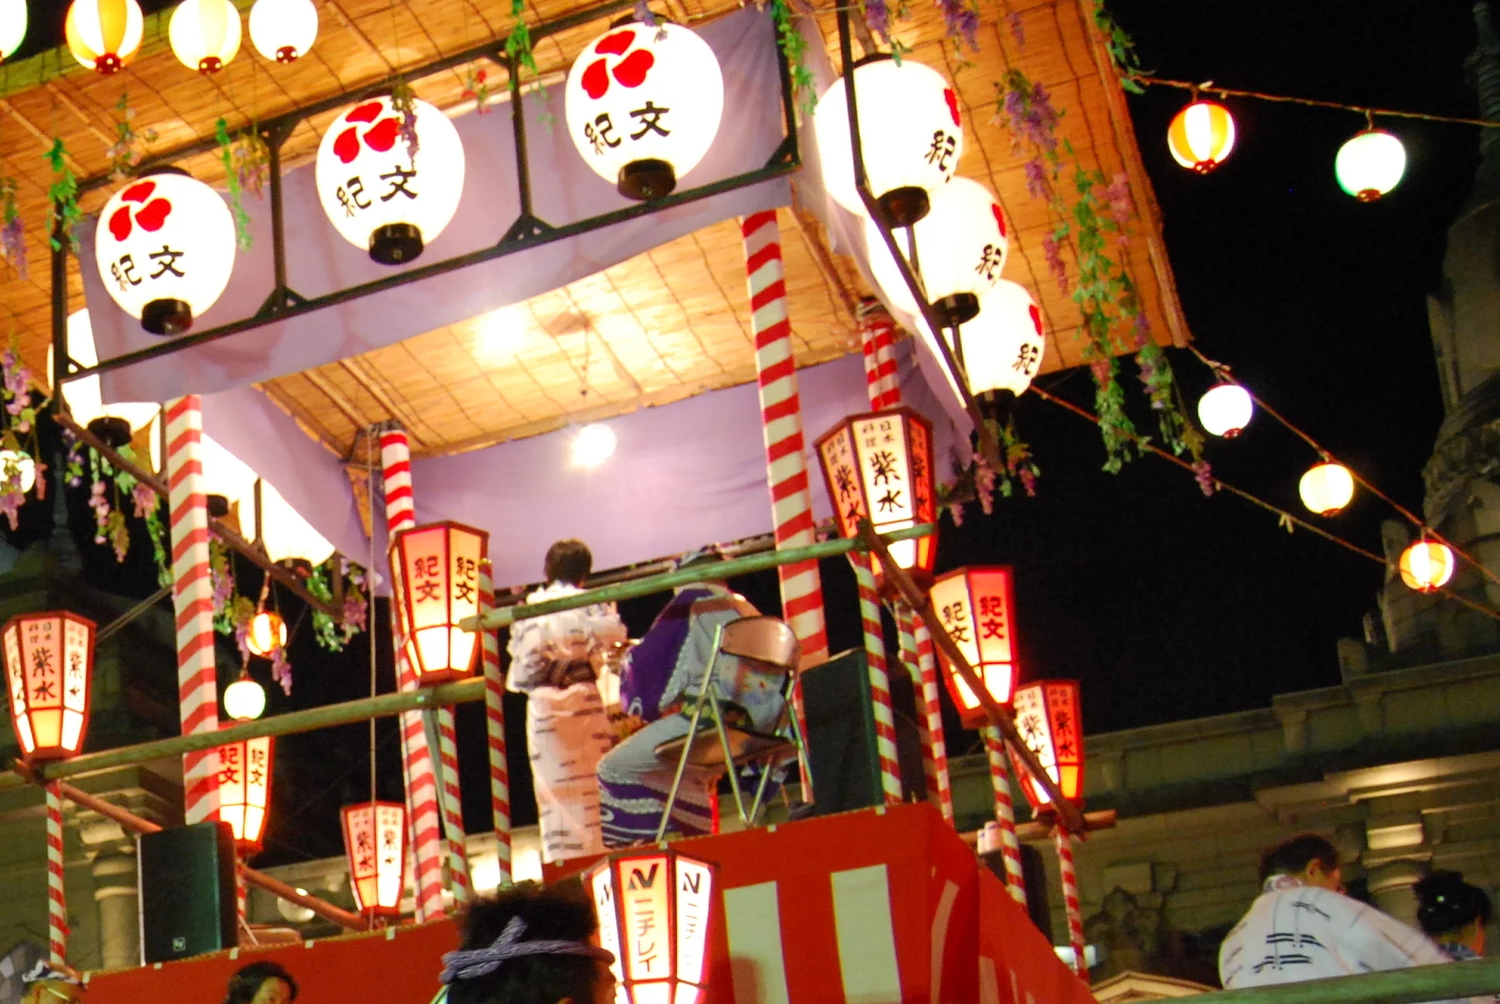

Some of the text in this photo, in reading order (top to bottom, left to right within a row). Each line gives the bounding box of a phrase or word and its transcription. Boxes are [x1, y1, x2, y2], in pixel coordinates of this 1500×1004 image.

[584, 101, 670, 155] 紀文
[336, 165, 419, 219] 紀文
[110, 245, 187, 293] 紀文
[869, 451, 904, 513] 紫水
[414, 556, 440, 603] 紀文
[455, 556, 474, 604] 紀文
[943, 601, 969, 643] 紀文
[980, 596, 1004, 639] 紀文
[32, 647, 55, 701] 紫水
[218, 748, 238, 784] 紀文
[250, 749, 264, 786] 紀文
[634, 899, 657, 972] ニチレイ
